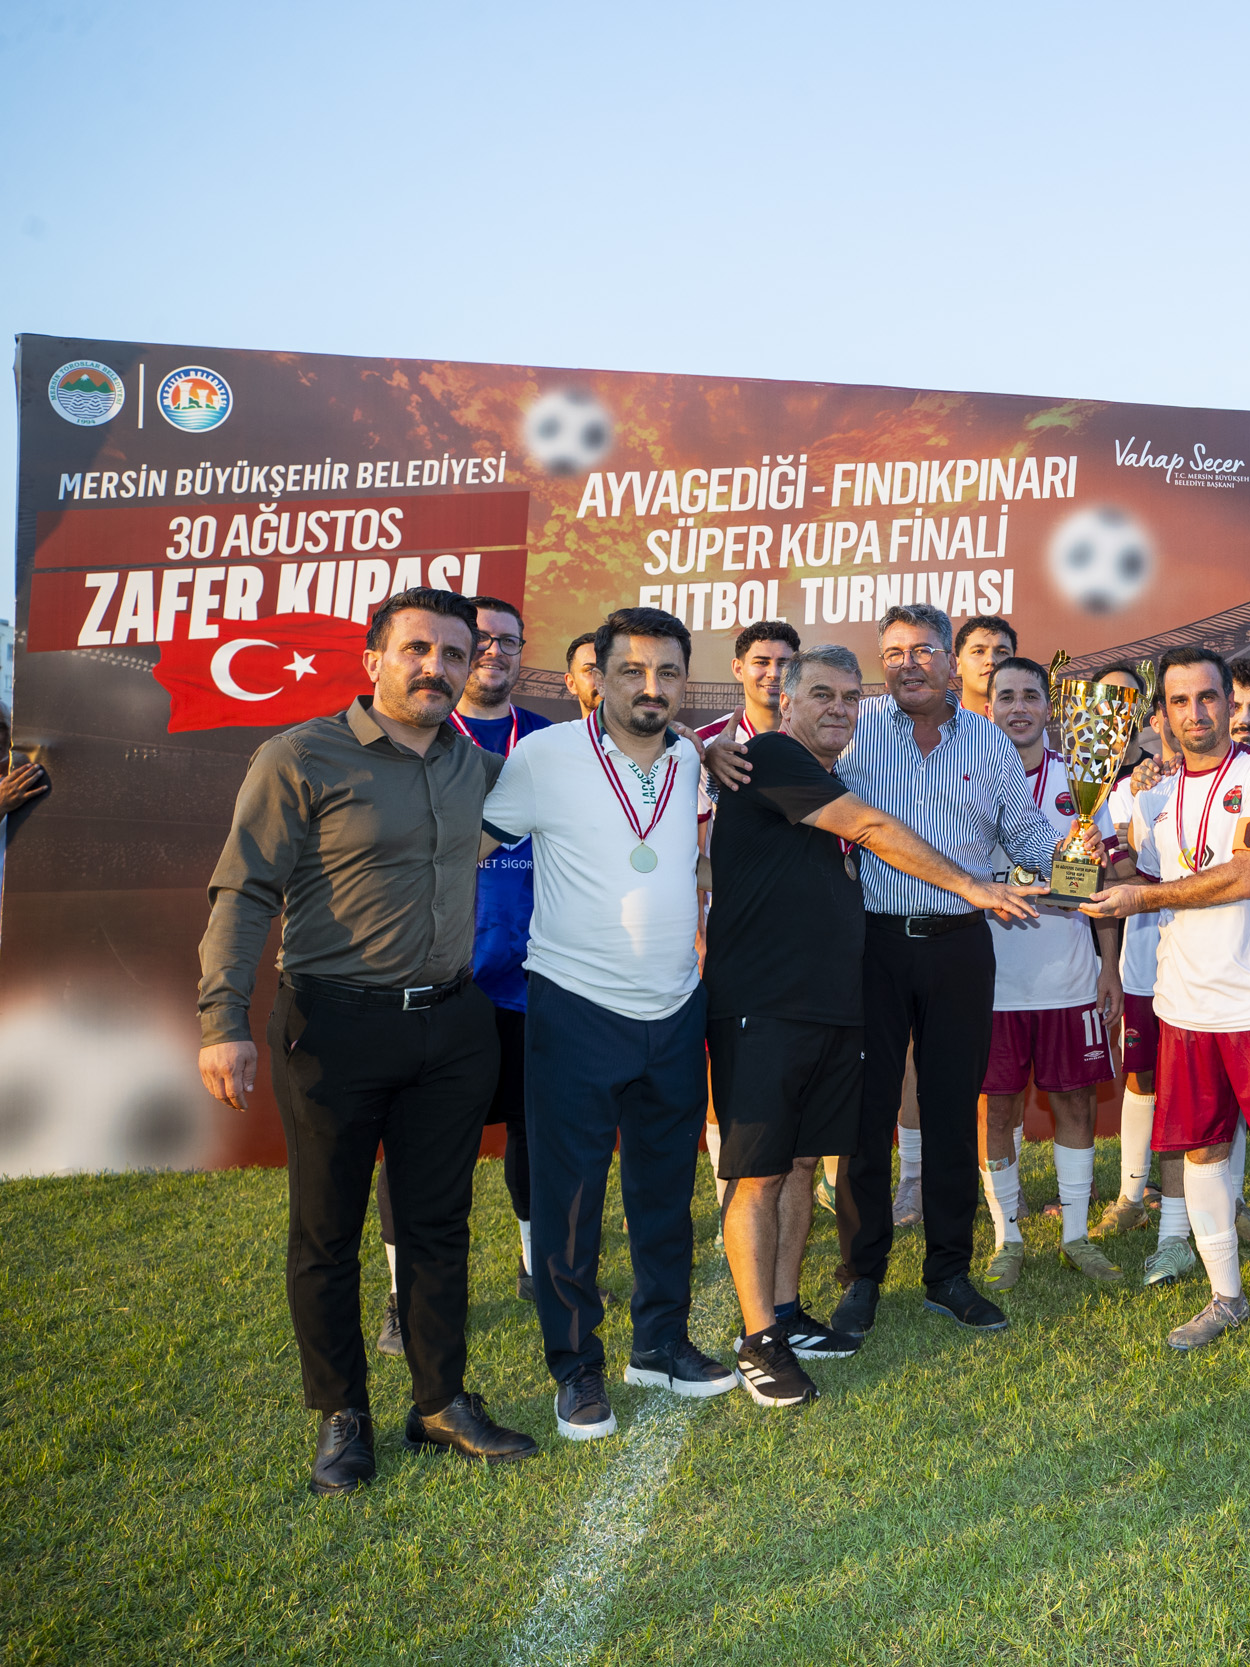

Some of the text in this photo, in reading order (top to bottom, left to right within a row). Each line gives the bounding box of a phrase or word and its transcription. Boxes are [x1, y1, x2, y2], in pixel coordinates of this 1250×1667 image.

[59, 360, 101, 374] TOROSLAR
[58, 451, 507, 500] MERSİN BÜYÜKŞEHİR BELEDİYESİ
[1114, 436, 1246, 483] Vahap Seçer
[1174, 472, 1186, 480] T.C.
[1188, 472, 1214, 481] MERSİN
[576, 453, 808, 519] AYVAGEDİĞİ
[831, 455, 1078, 509] FINDIKPINARI
[1206, 480, 1235, 489] BAŞKANI
[166, 503, 404, 561] 30 AĞUSTOS
[643, 505, 1009, 576] SÜPER KUPA FİNALİ
[77, 565, 264, 646] ZAFER
[800, 568, 1014, 625] TURNUVASI
[476, 859, 498, 869] NET
[1082, 1009, 1103, 1047] 11
